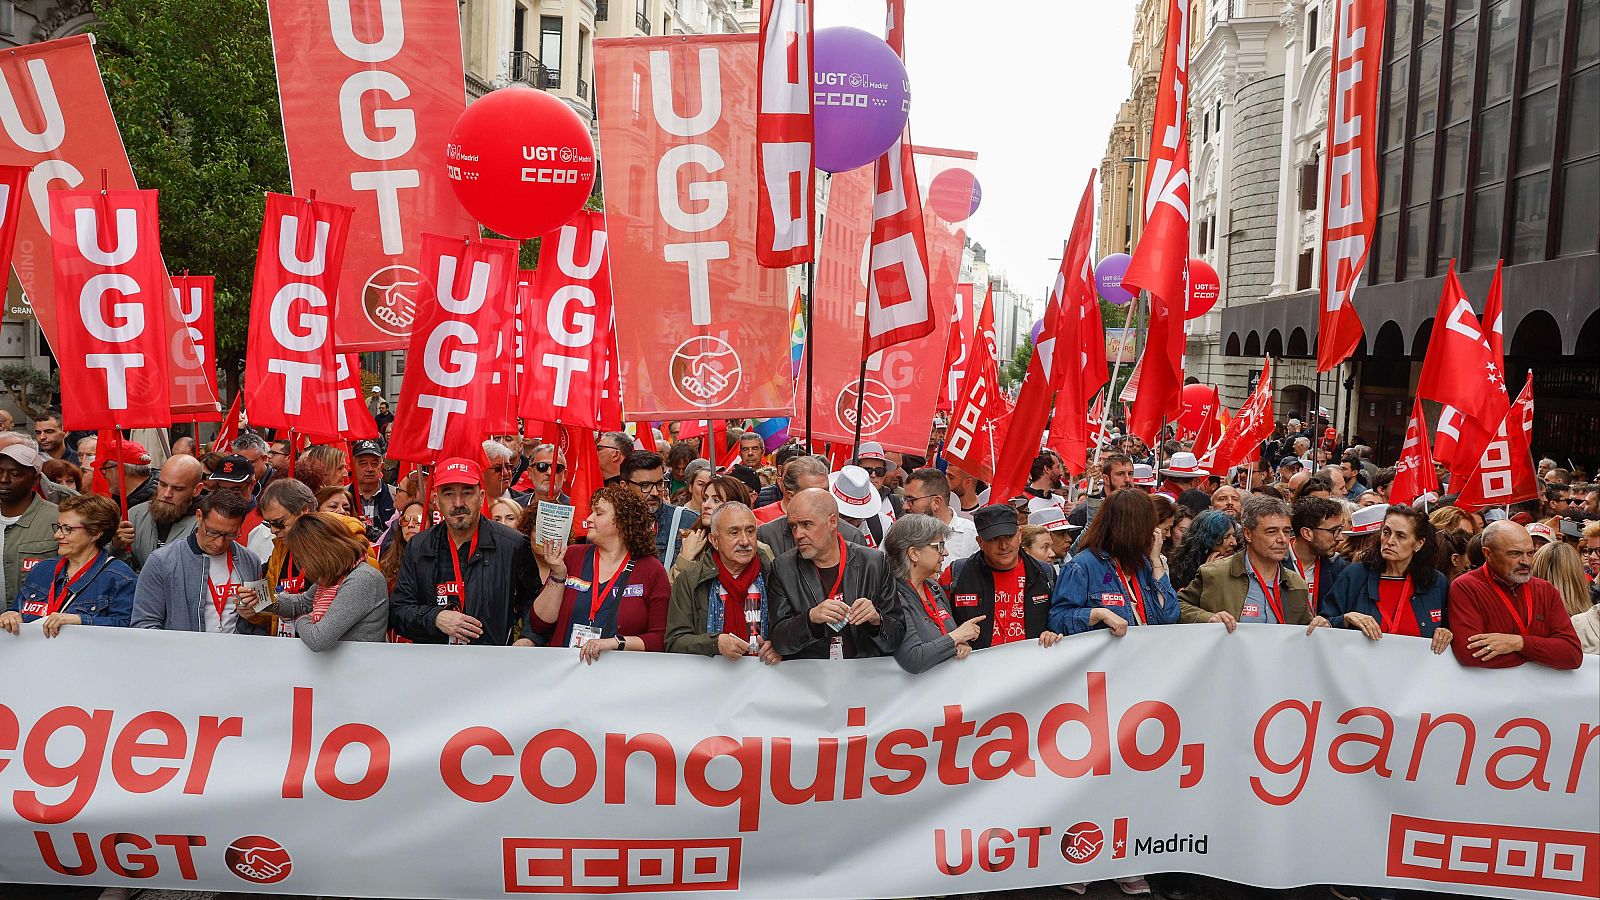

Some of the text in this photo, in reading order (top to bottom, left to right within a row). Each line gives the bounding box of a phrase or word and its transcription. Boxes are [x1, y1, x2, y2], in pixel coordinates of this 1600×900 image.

[815, 73, 847, 86] UGT
[328, 0, 421, 255] UGT
[523, 146, 557, 161] UGT
[521, 167, 578, 184] CCOO
[650, 48, 729, 326] UGT
[11, 306, 32, 314] GRAN
[75, 208, 144, 409] UGT
[268, 215, 331, 416] UGT
[542, 225, 607, 408] UGT
[169, 287, 206, 405] UGT
[417, 255, 490, 450] UGT
[24, 602, 43, 613] UGT
[281, 686, 391, 801] lo
[439, 671, 1205, 832] conquistado,
[33, 830, 207, 881] UGT
[514, 846, 731, 887] CCOO
[934, 826, 1208, 876] UGT Madrid
[1401, 829, 1586, 882] CCOO
